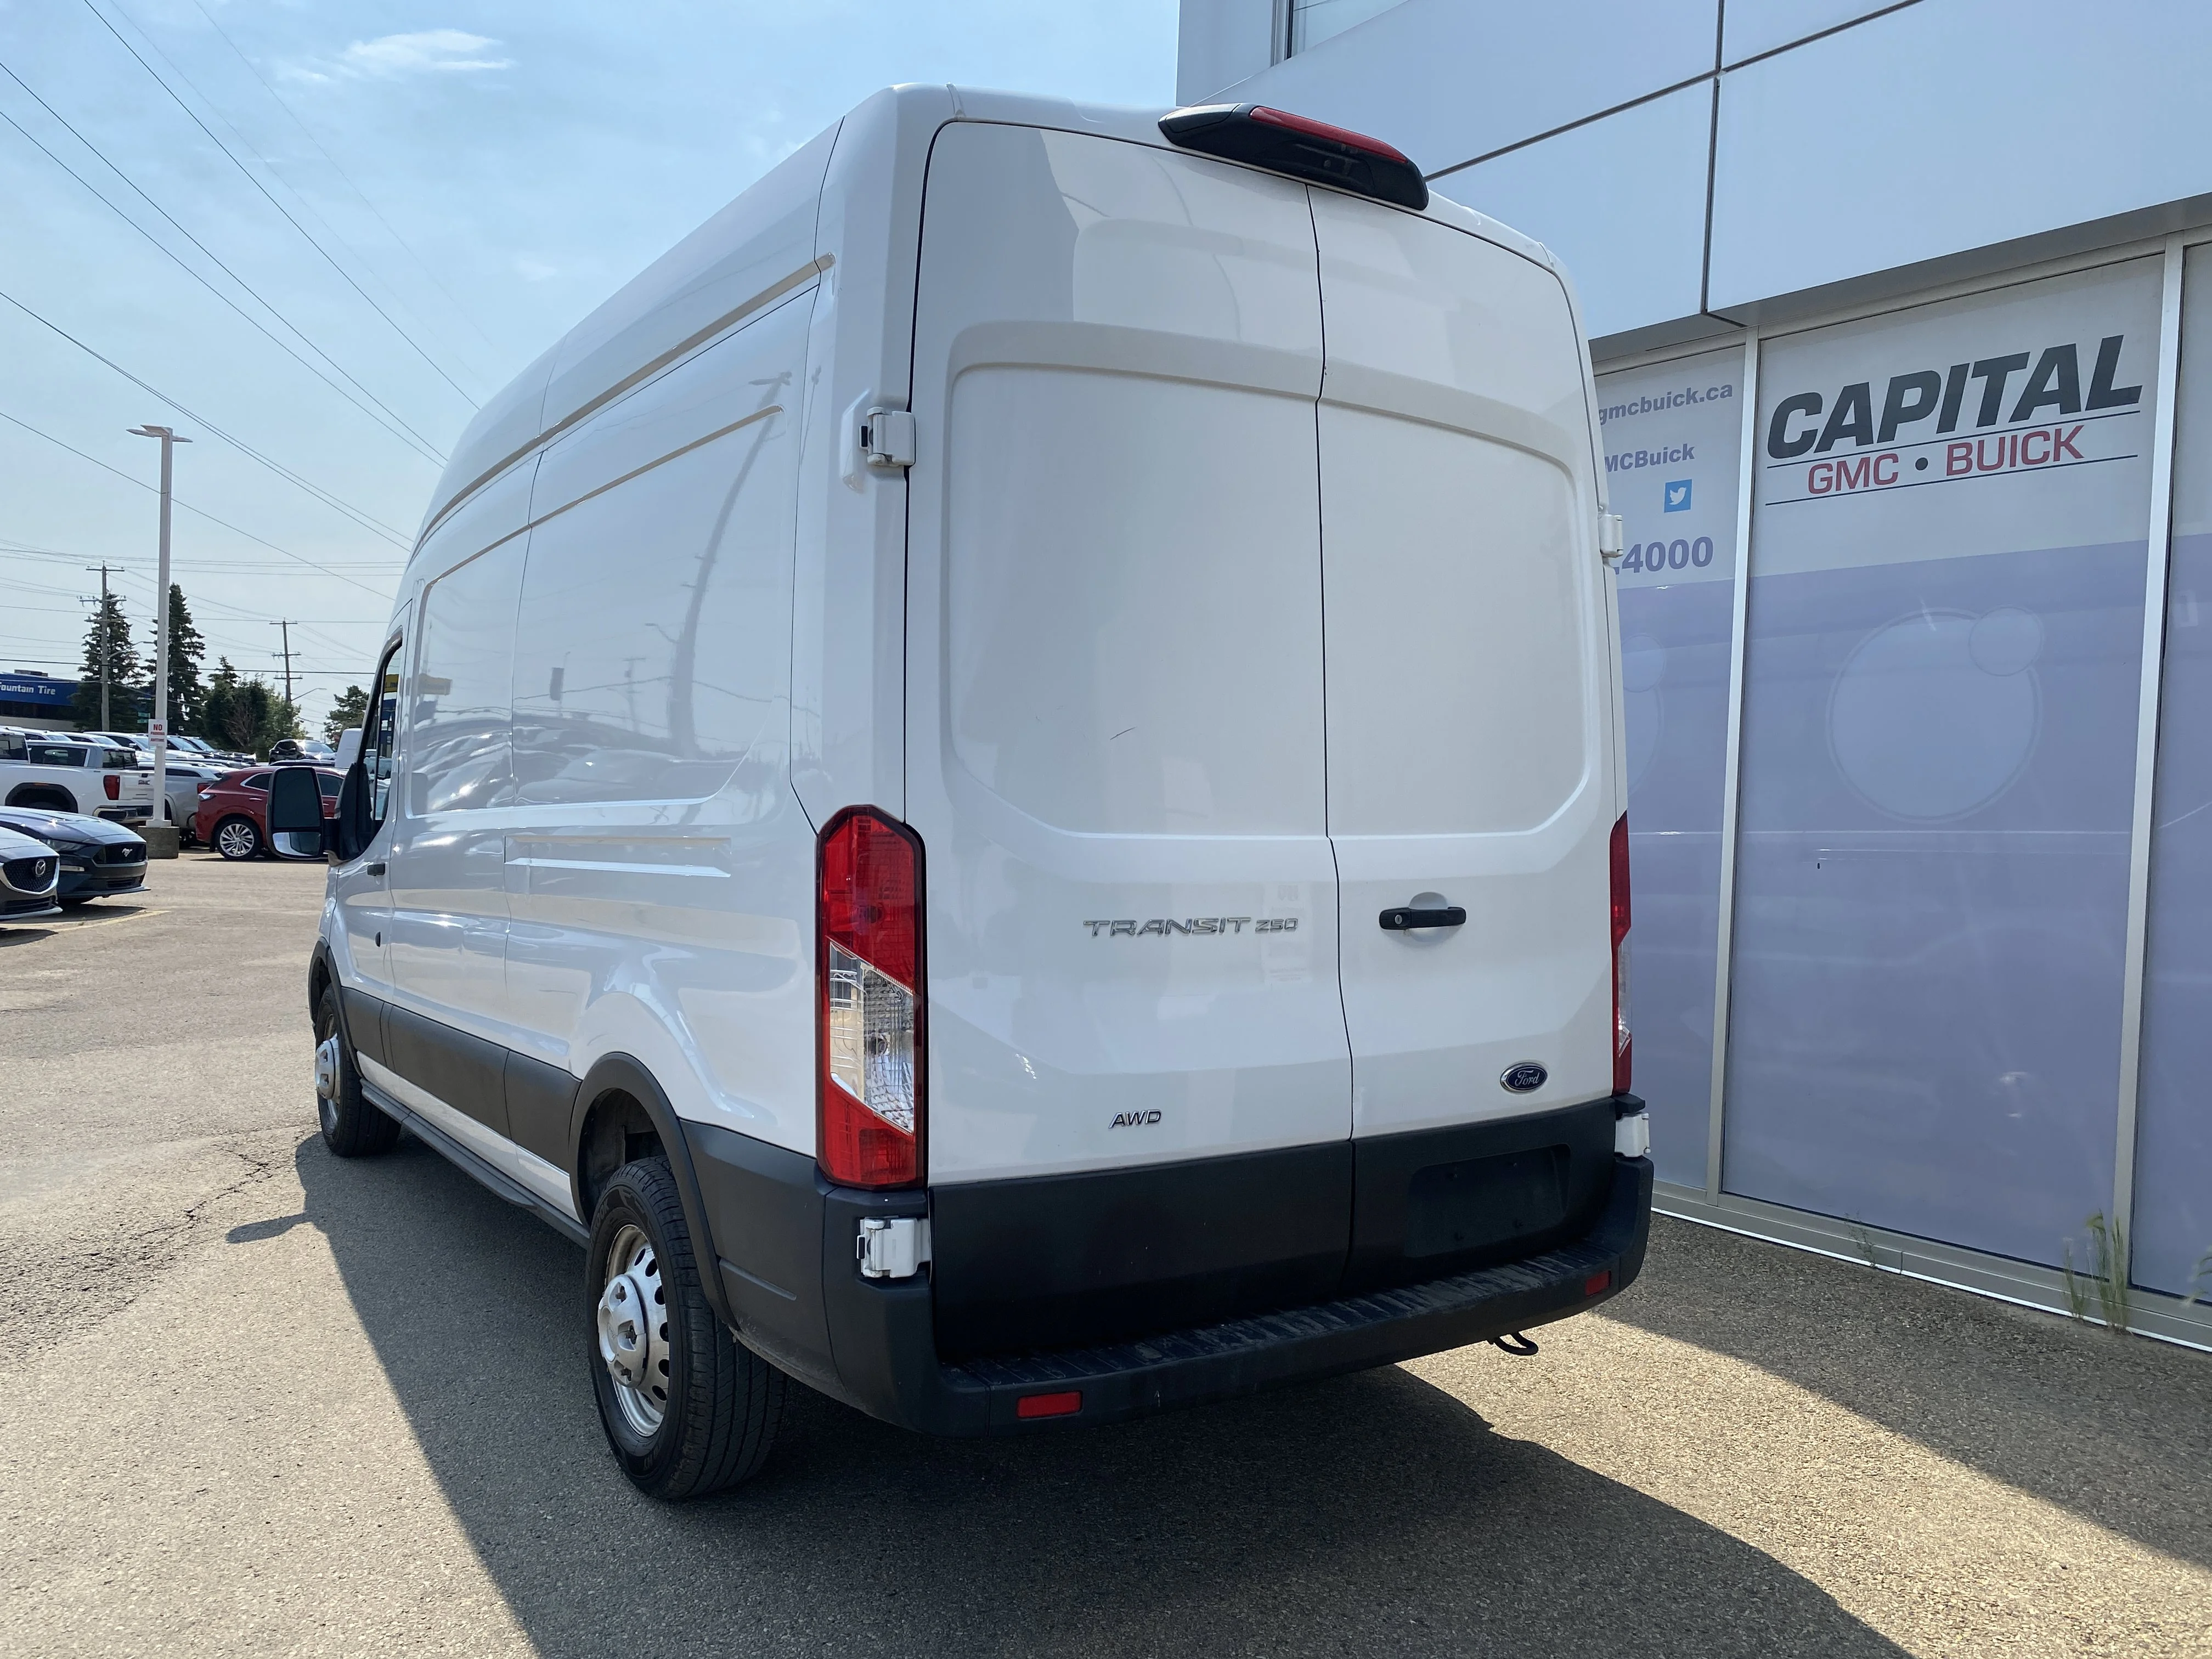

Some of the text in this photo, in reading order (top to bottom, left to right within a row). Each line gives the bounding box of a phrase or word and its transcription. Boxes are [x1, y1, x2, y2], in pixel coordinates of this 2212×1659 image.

[1767, 334, 2143, 459] CAPITAL
[1808, 425, 2085, 494] GMC BUICK
[0, 682, 56, 695] ountain Tire
[1083, 917, 1299, 936] TRANSIT 250
[1514, 1069, 1541, 1087] Ford
[1108, 1109, 1162, 1128] AWD
